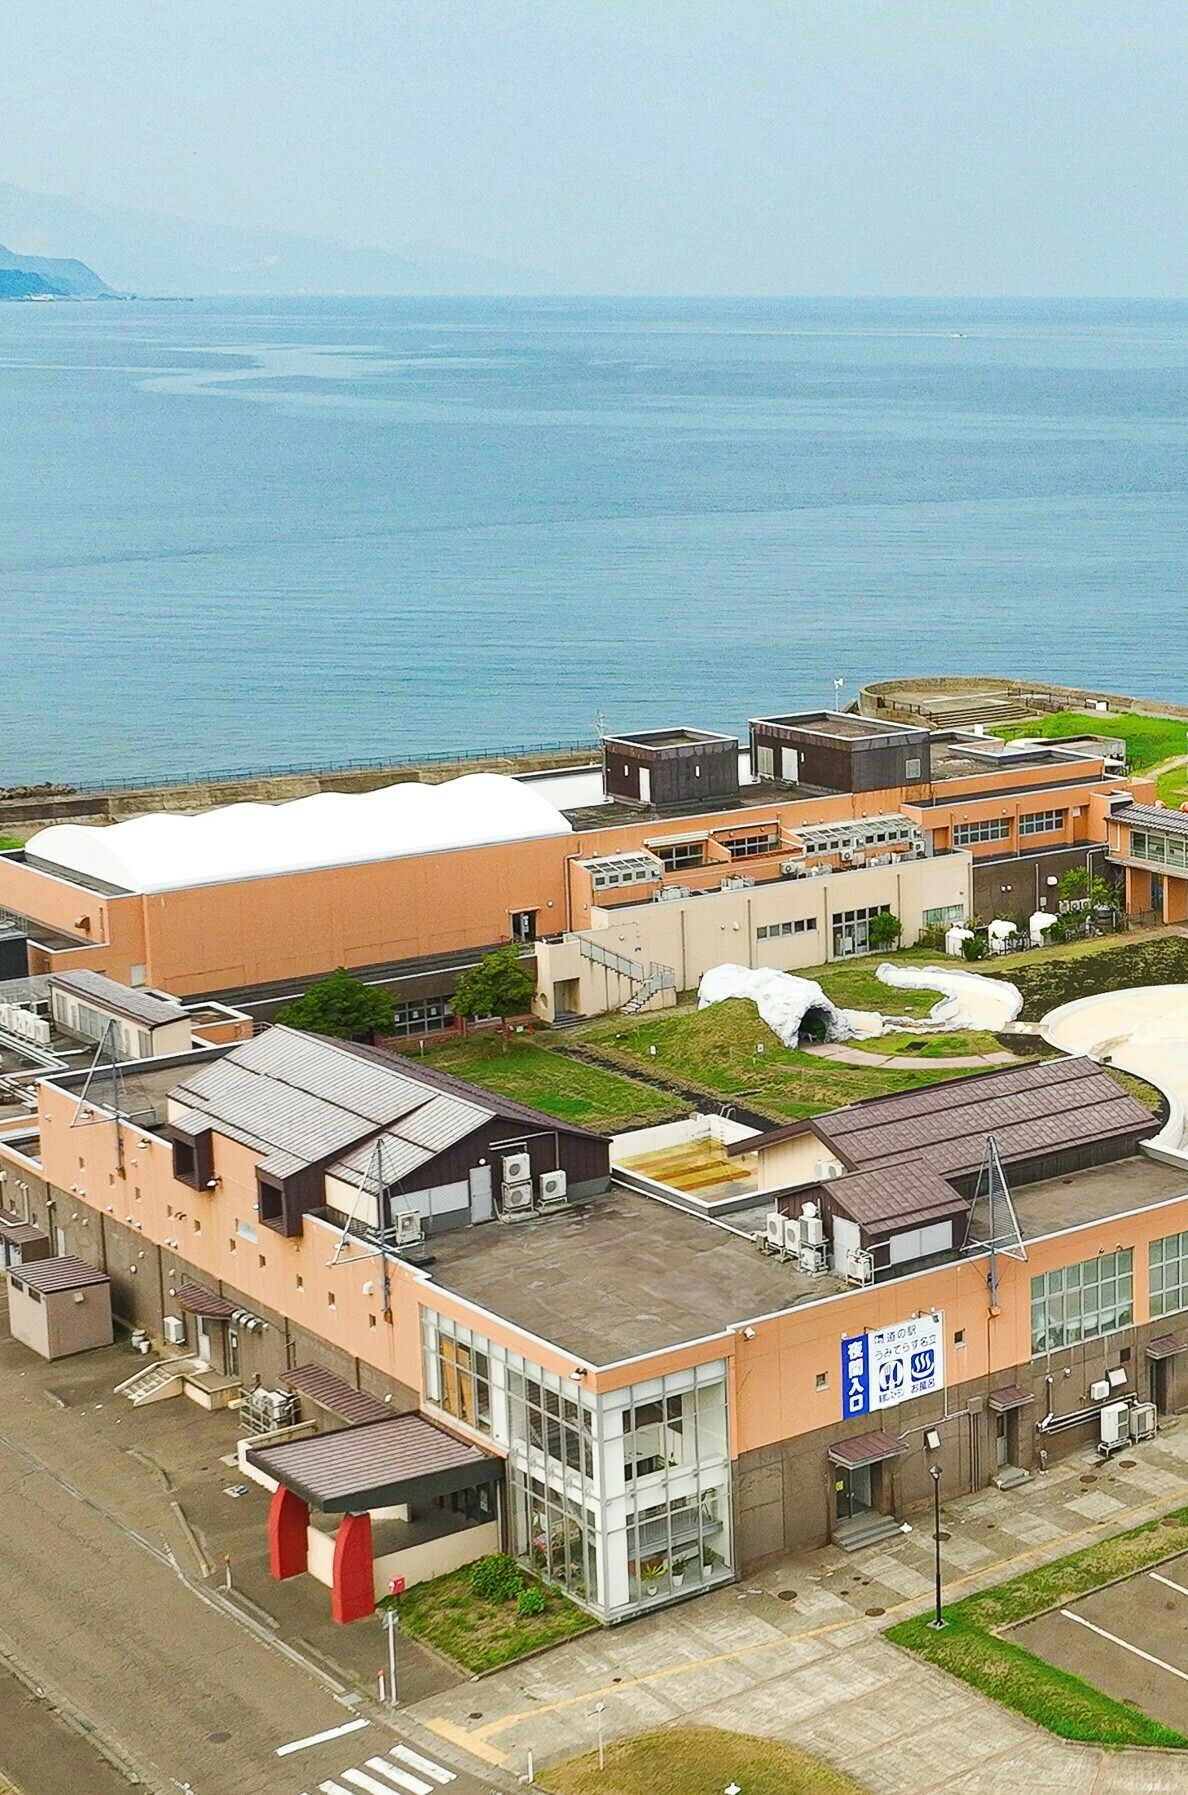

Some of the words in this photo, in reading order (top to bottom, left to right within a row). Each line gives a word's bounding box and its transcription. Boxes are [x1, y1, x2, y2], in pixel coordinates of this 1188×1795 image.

[886, 1325, 917, 1342] 道の駅
[875, 1334, 937, 1360] うみてらす名立
[911, 1379, 936, 1393] お風呂
